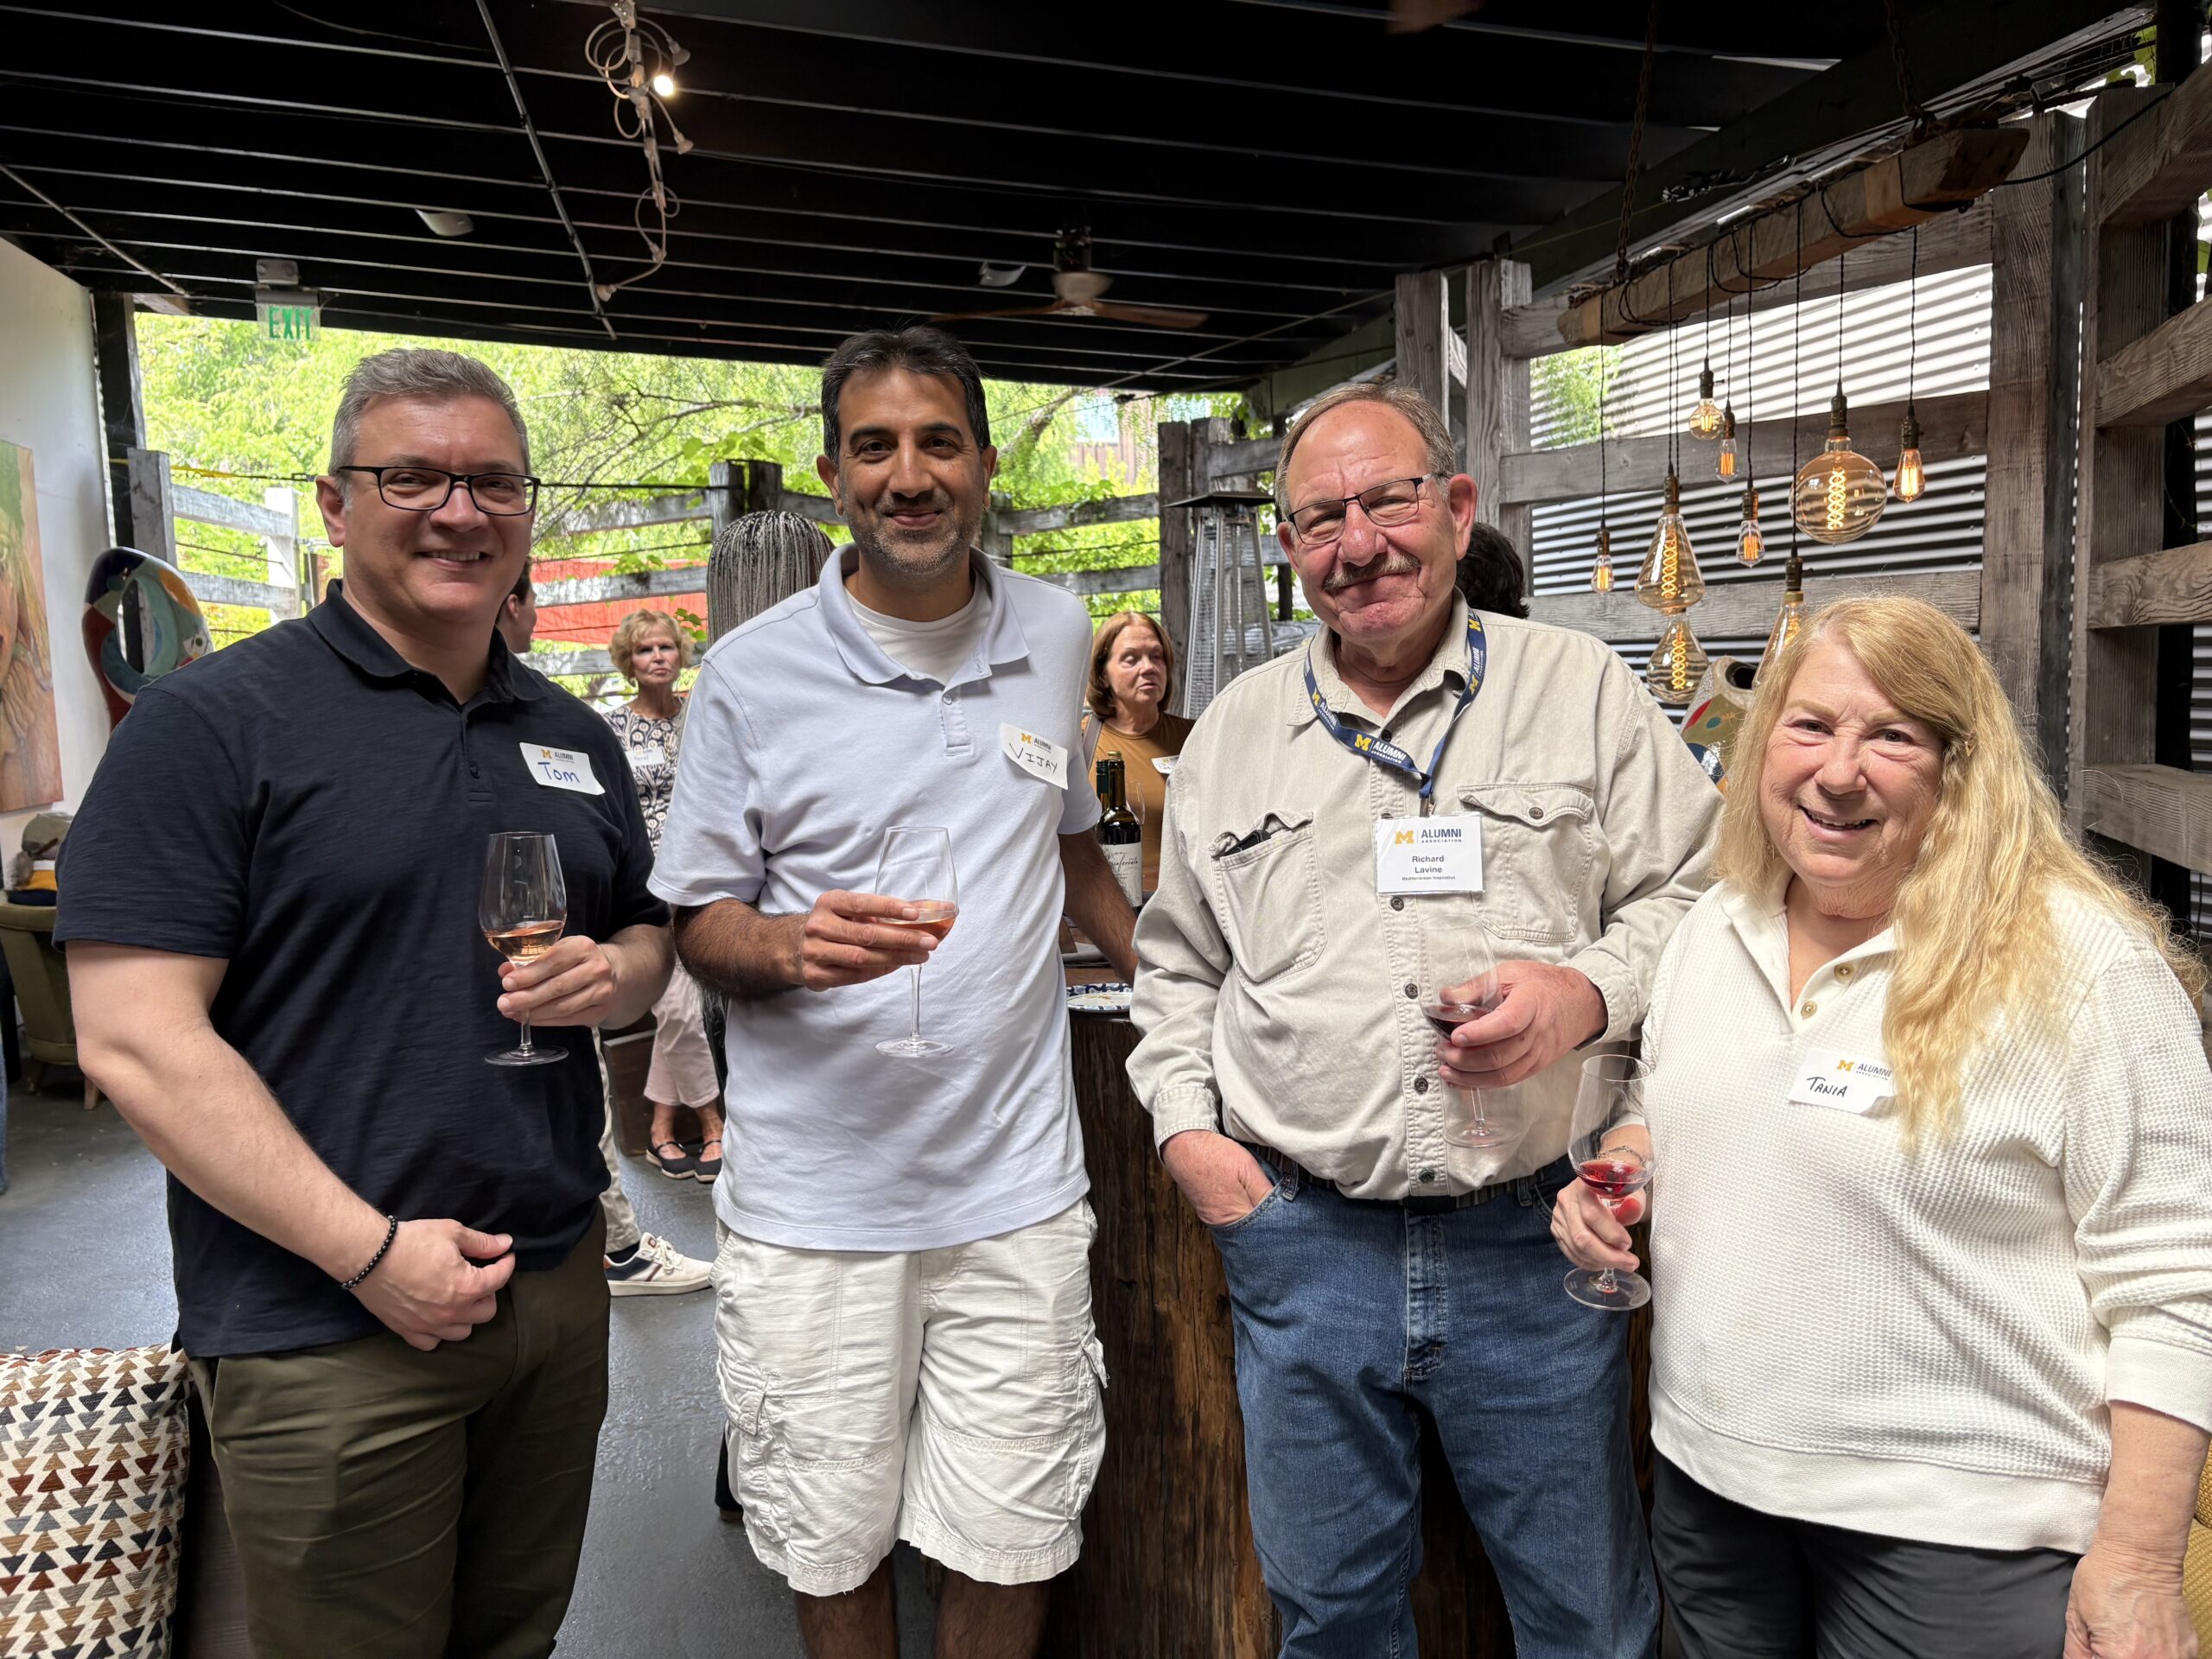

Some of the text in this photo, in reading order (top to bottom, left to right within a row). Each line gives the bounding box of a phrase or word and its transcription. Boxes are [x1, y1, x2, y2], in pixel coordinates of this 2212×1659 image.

[268, 306, 313, 340] EXIT
[1020, 732, 1033, 745] M
[1033, 737, 1052, 751] ALUMNI
[1354, 734, 1407, 761] M ALUMNI
[1008, 741, 1058, 774] VIJAY
[537, 761, 580, 784] Tom
[1395, 828, 1462, 845] M ALUMNI
[1836, 1059, 1892, 1077] M ALUMNI
[1807, 1076, 1848, 1097] TANIA
